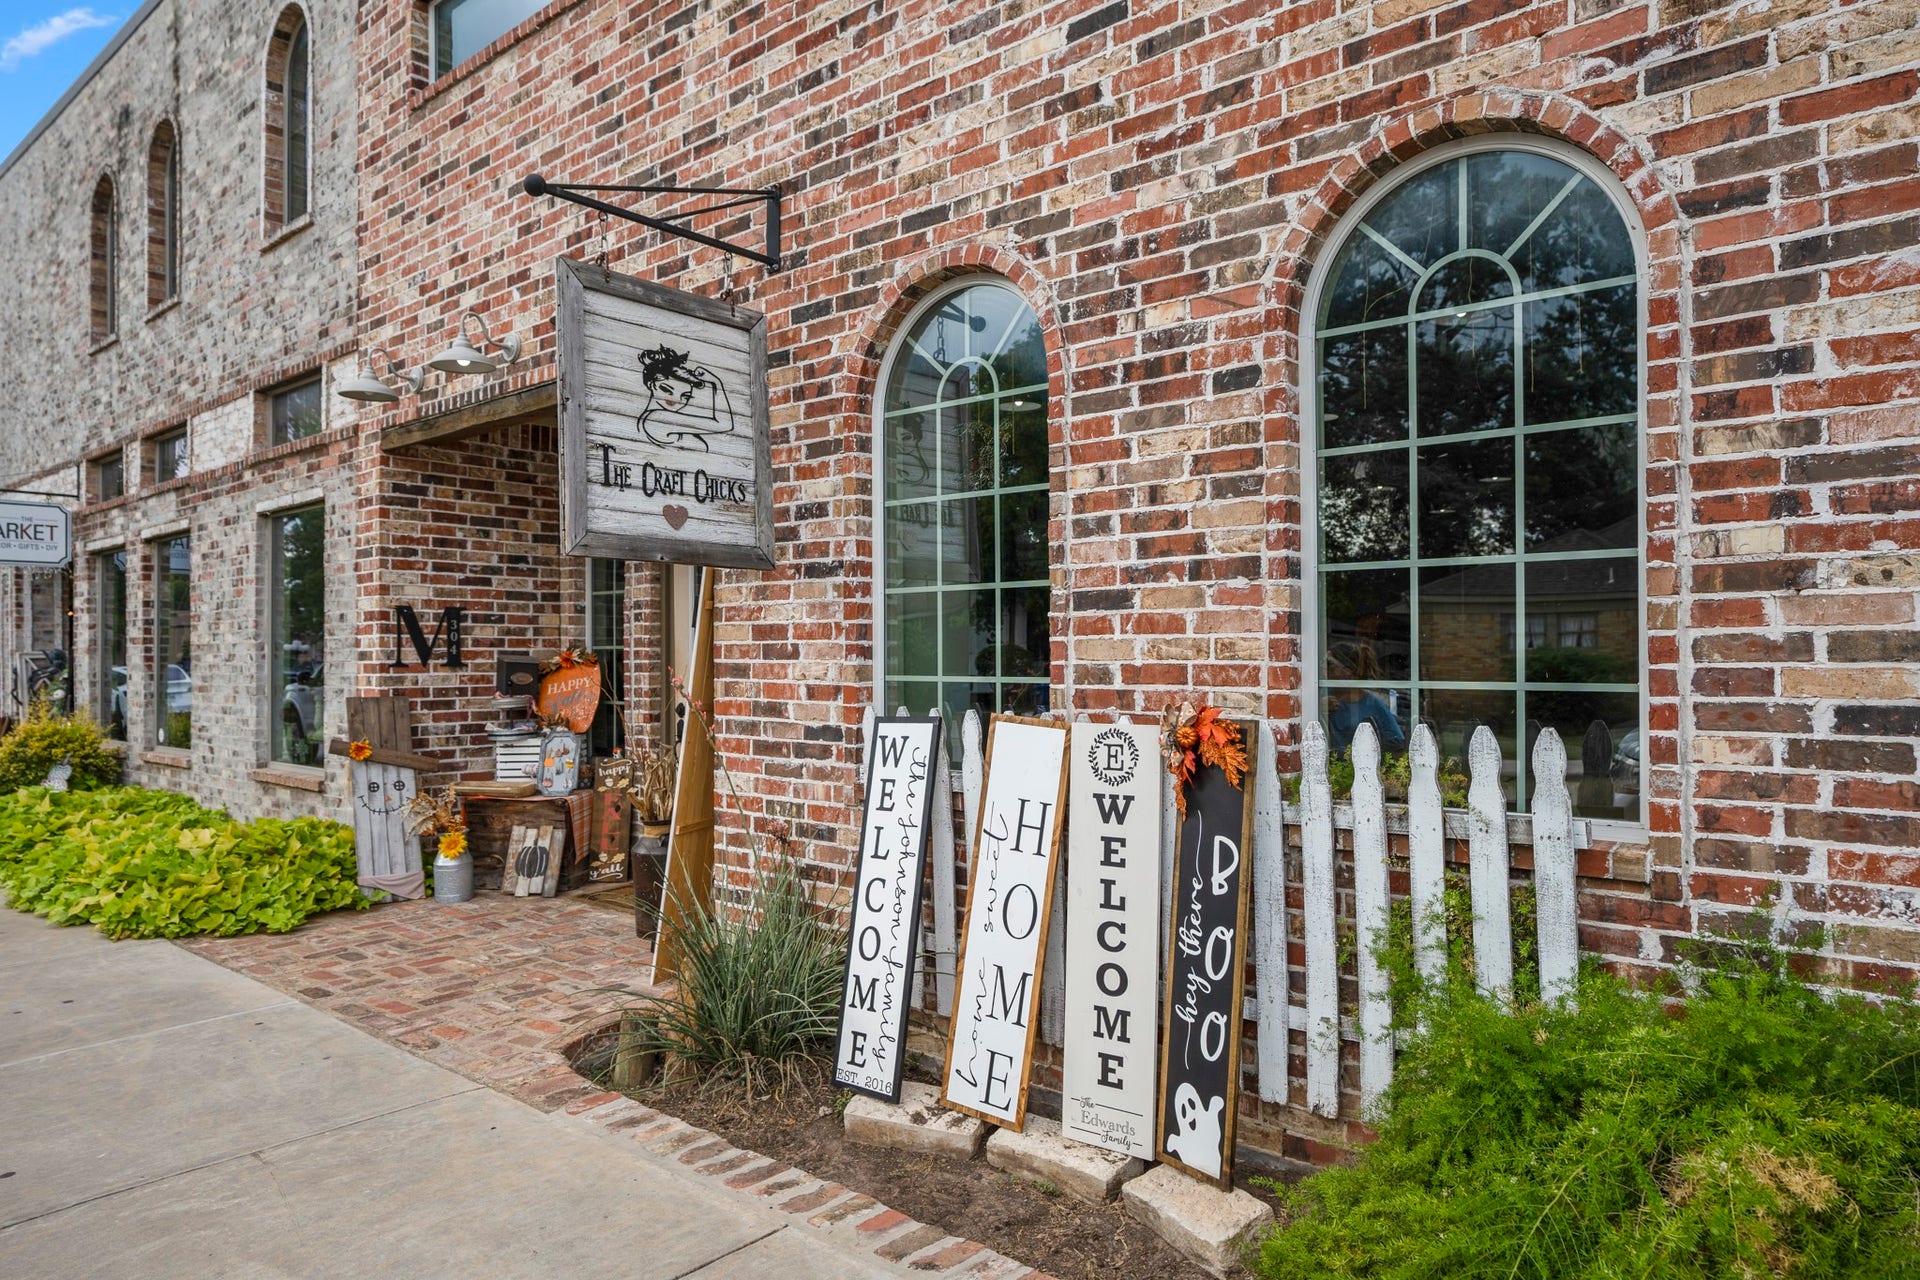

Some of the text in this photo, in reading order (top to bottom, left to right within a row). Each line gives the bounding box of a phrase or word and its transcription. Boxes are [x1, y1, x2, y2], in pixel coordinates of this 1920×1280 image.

[596, 443, 746, 504] THE CRAFT CHICKS
[18, 543, 40, 551] GIFTS
[389, 603, 468, 668] M
[449, 619, 459, 655] 304
[547, 676, 592, 696] HAPPY
[598, 764, 632, 777] happy
[1103, 743, 1124, 772] E
[846, 735, 910, 1068] WELCOME
[955, 801, 1009, 1088] home sweet
[979, 797, 1053, 1112] HOME
[1092, 792, 1135, 1090] WELCOME
[1175, 810, 1211, 1070] hey there
[1200, 835, 1240, 1062] BOO
[837, 1068, 893, 1094] EST. 2016
[1080, 1096, 1096, 1109] The
[1081, 1110, 1136, 1136] Edwards
[1101, 1129, 1131, 1151] Family
